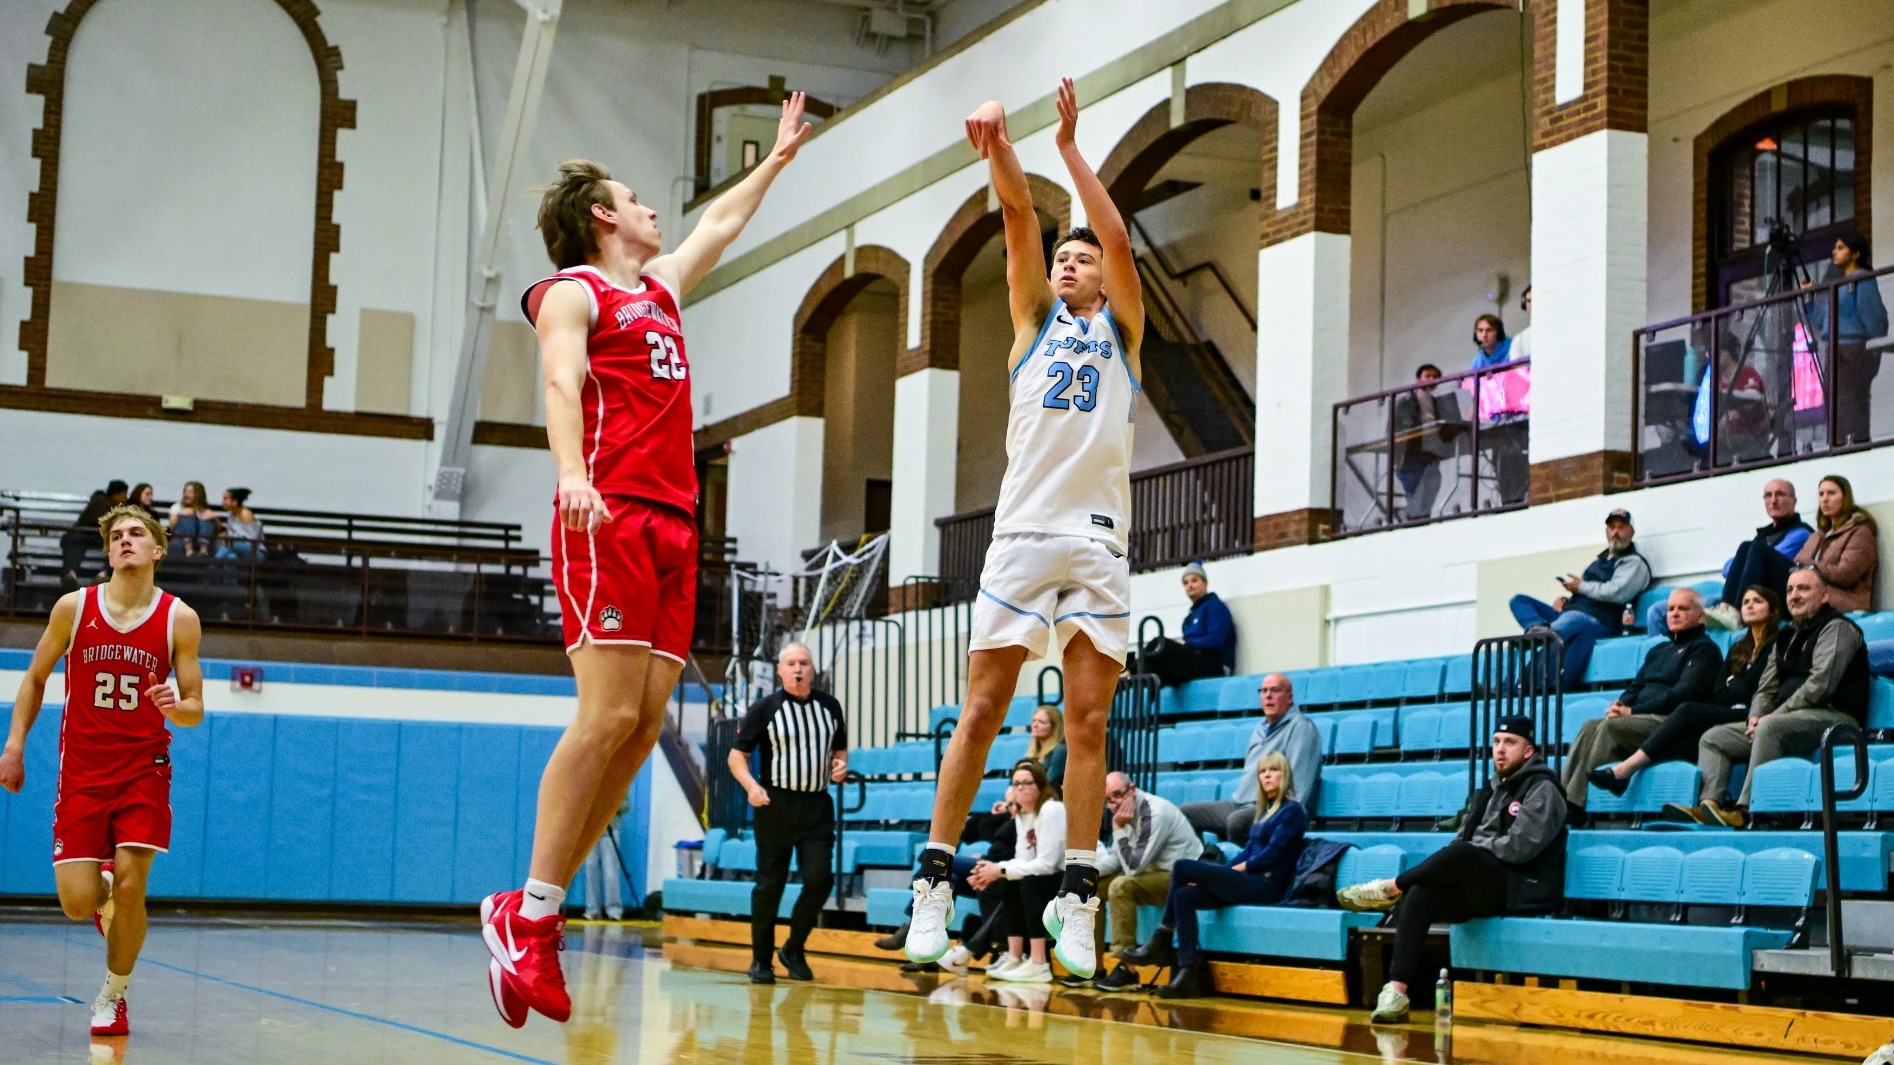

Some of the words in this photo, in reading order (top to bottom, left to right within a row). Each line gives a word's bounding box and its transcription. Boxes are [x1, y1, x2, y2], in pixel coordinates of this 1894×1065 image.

[645, 331, 687, 380] 22
[1043, 361, 1099, 412] 23
[83, 644, 158, 673] BRIDGEWATER
[94, 671, 140, 711] 25
